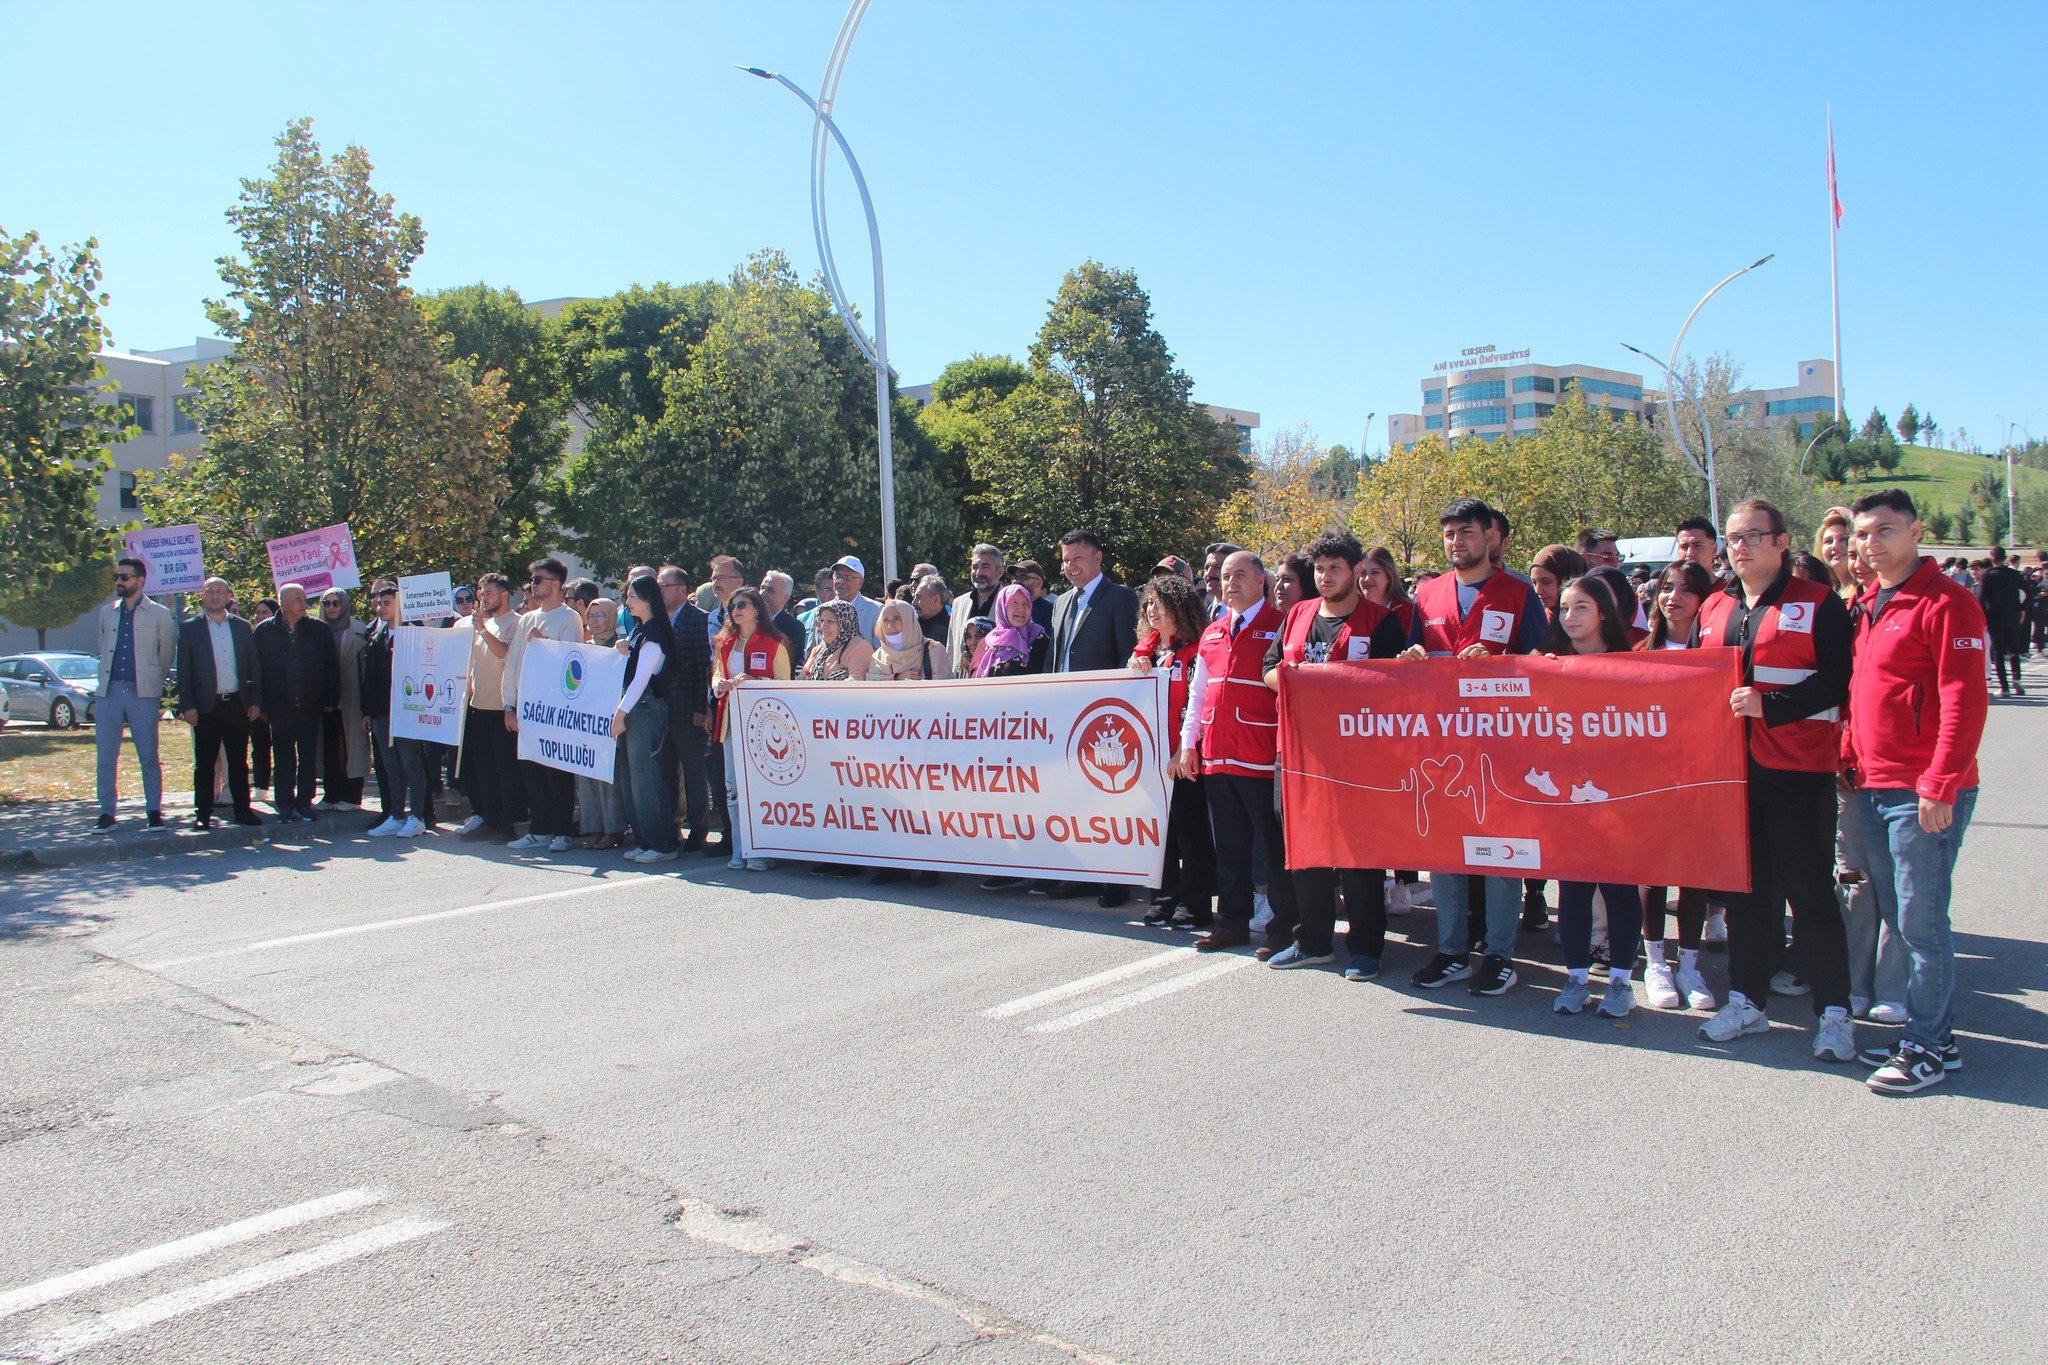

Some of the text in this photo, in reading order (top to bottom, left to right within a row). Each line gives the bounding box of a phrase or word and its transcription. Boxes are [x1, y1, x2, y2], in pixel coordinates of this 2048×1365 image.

[1433, 348, 1530, 371] AHİ EVRAN ÜNİVERSİTESİ
[1461, 344, 1496, 356] KIRŞEHİR
[142, 538, 159, 549] KANSER
[160, 536, 177, 546] İHMALE
[271, 535, 321, 552] Meme Kanserinde
[273, 549, 320, 568] Erken Tanı
[276, 568, 292, 578] Hayat
[432, 589, 446, 597] Değil
[1466, 681, 1523, 692] 3-4 EKİM
[419, 714, 442, 727] MUTLU YAŞA
[522, 700, 614, 738] SAĞLIK HİZMETLERİ
[812, 711, 1054, 744] EN BÜYÜK AİLEMİZİN,
[1338, 706, 1667, 744] DÜNYA YÜRÜYÜŞ GÜNÜ
[539, 738, 595, 768] TOPLULUĞU
[830, 756, 1040, 793] TÜRKİYE’MİZİN
[759, 798, 1160, 846] 2025 AİLE YILI KUTLU OLSUN
